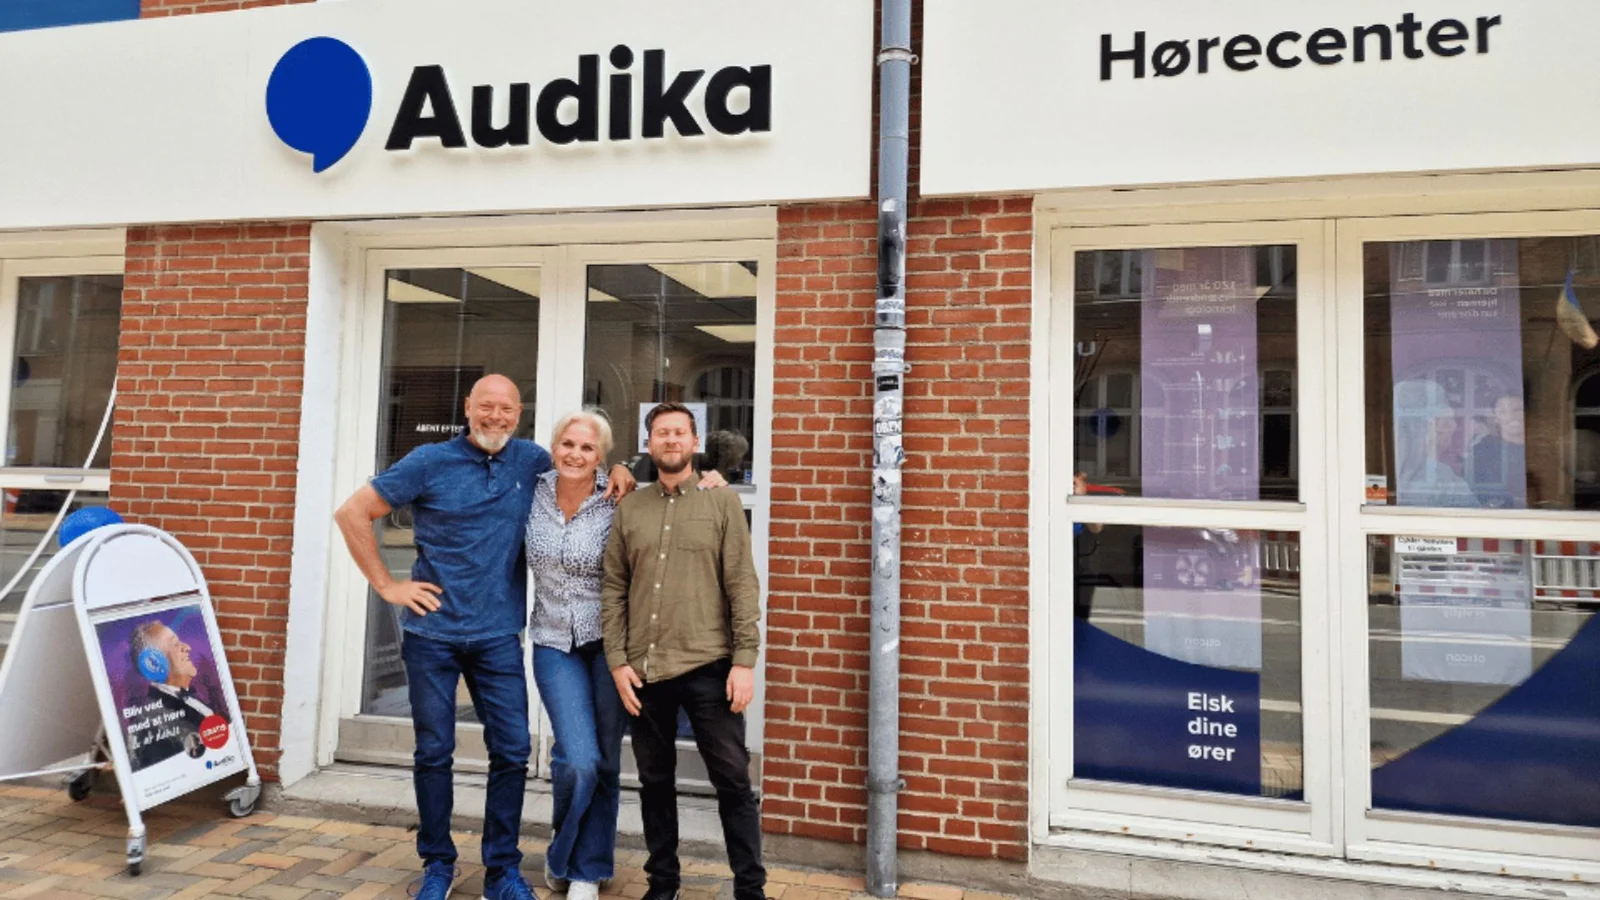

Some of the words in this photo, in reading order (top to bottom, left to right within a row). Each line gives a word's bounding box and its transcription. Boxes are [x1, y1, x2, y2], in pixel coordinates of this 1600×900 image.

[1099, 12, 1502, 81] Hørecenter
[384, 44, 773, 150] Audika
[1187, 691, 1235, 713] Elsk
[1187, 717, 1238, 738] dine
[1187, 744, 1236, 762] ører
